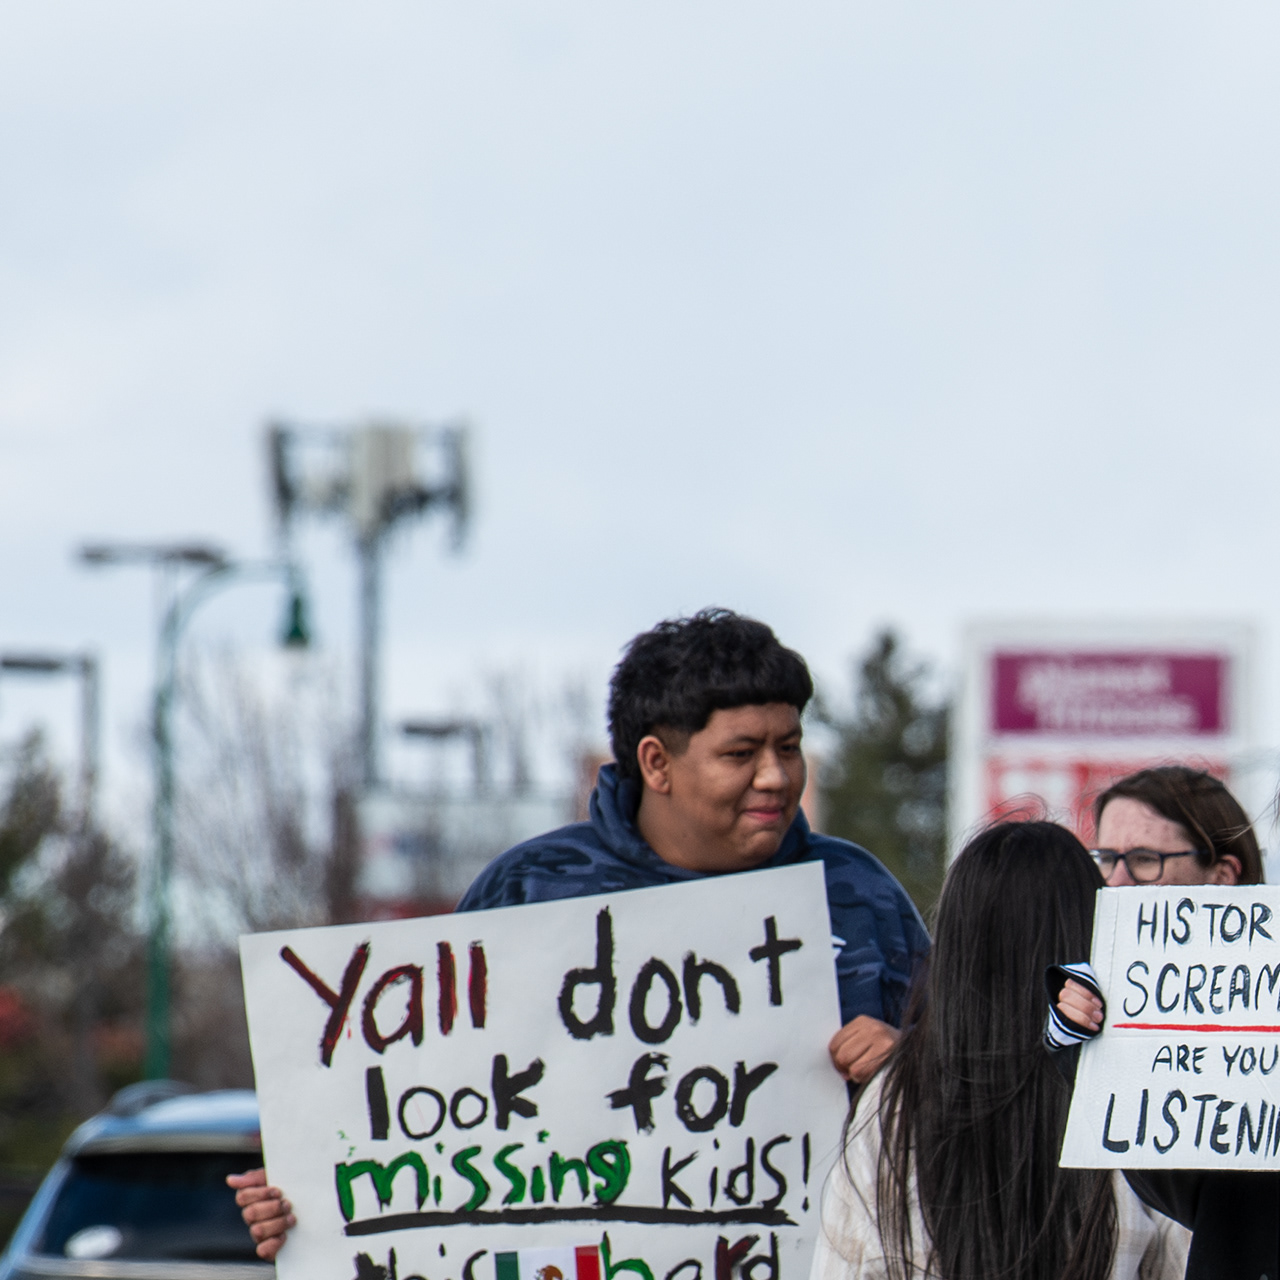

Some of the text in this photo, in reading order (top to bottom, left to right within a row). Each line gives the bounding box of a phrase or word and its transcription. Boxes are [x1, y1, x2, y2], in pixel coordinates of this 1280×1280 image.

[280, 905, 803, 1067] Yall dont
[366, 1052, 778, 1140] look for
[1152, 1044, 1279, 1077] ARE YOU
[335, 1129, 632, 1222] missing
